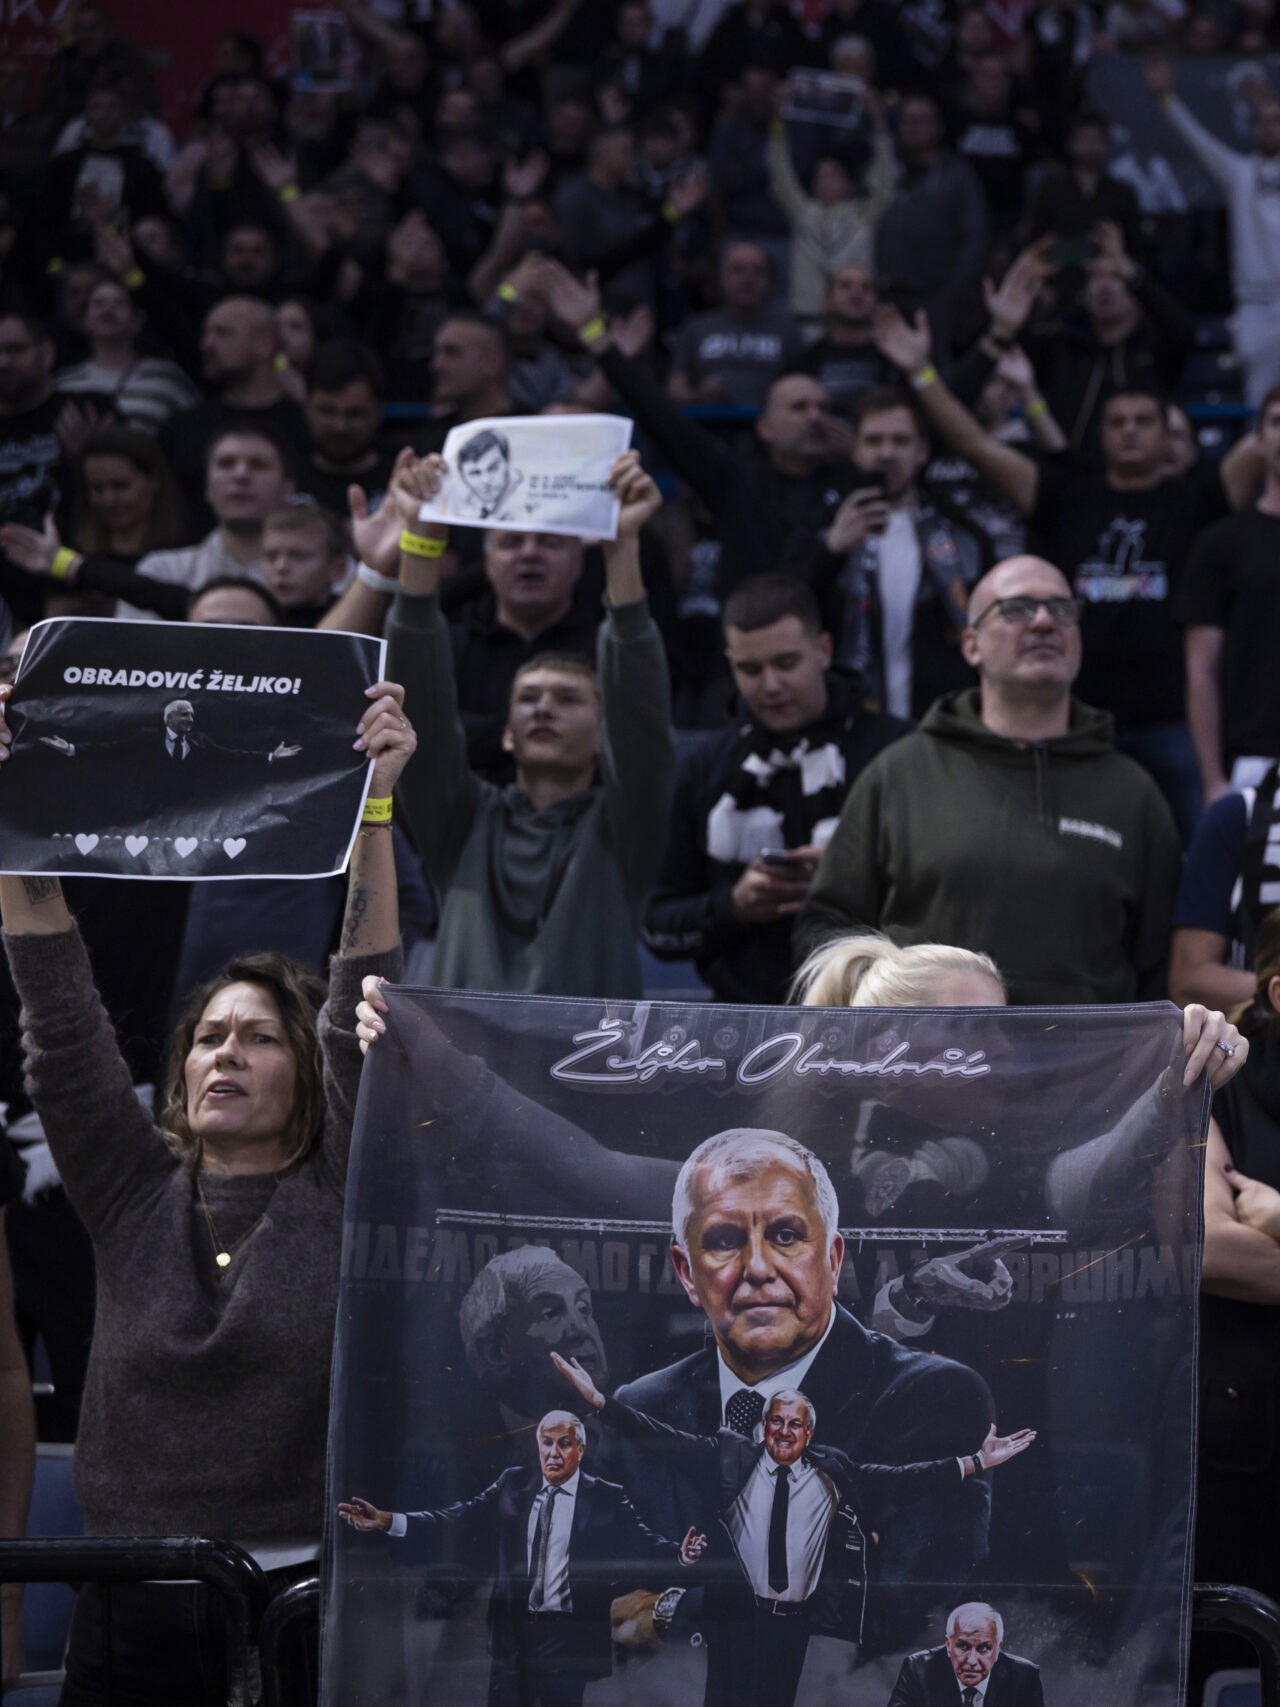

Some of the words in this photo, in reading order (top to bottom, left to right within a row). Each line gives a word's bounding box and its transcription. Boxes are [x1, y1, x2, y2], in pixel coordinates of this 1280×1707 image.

[63, 666, 205, 690] OBRADOVIĆ
[206, 669, 302, 695] ŽELJKO!
[550, 1019, 726, 1083] Željko
[737, 1033, 991, 1086] Obradović
